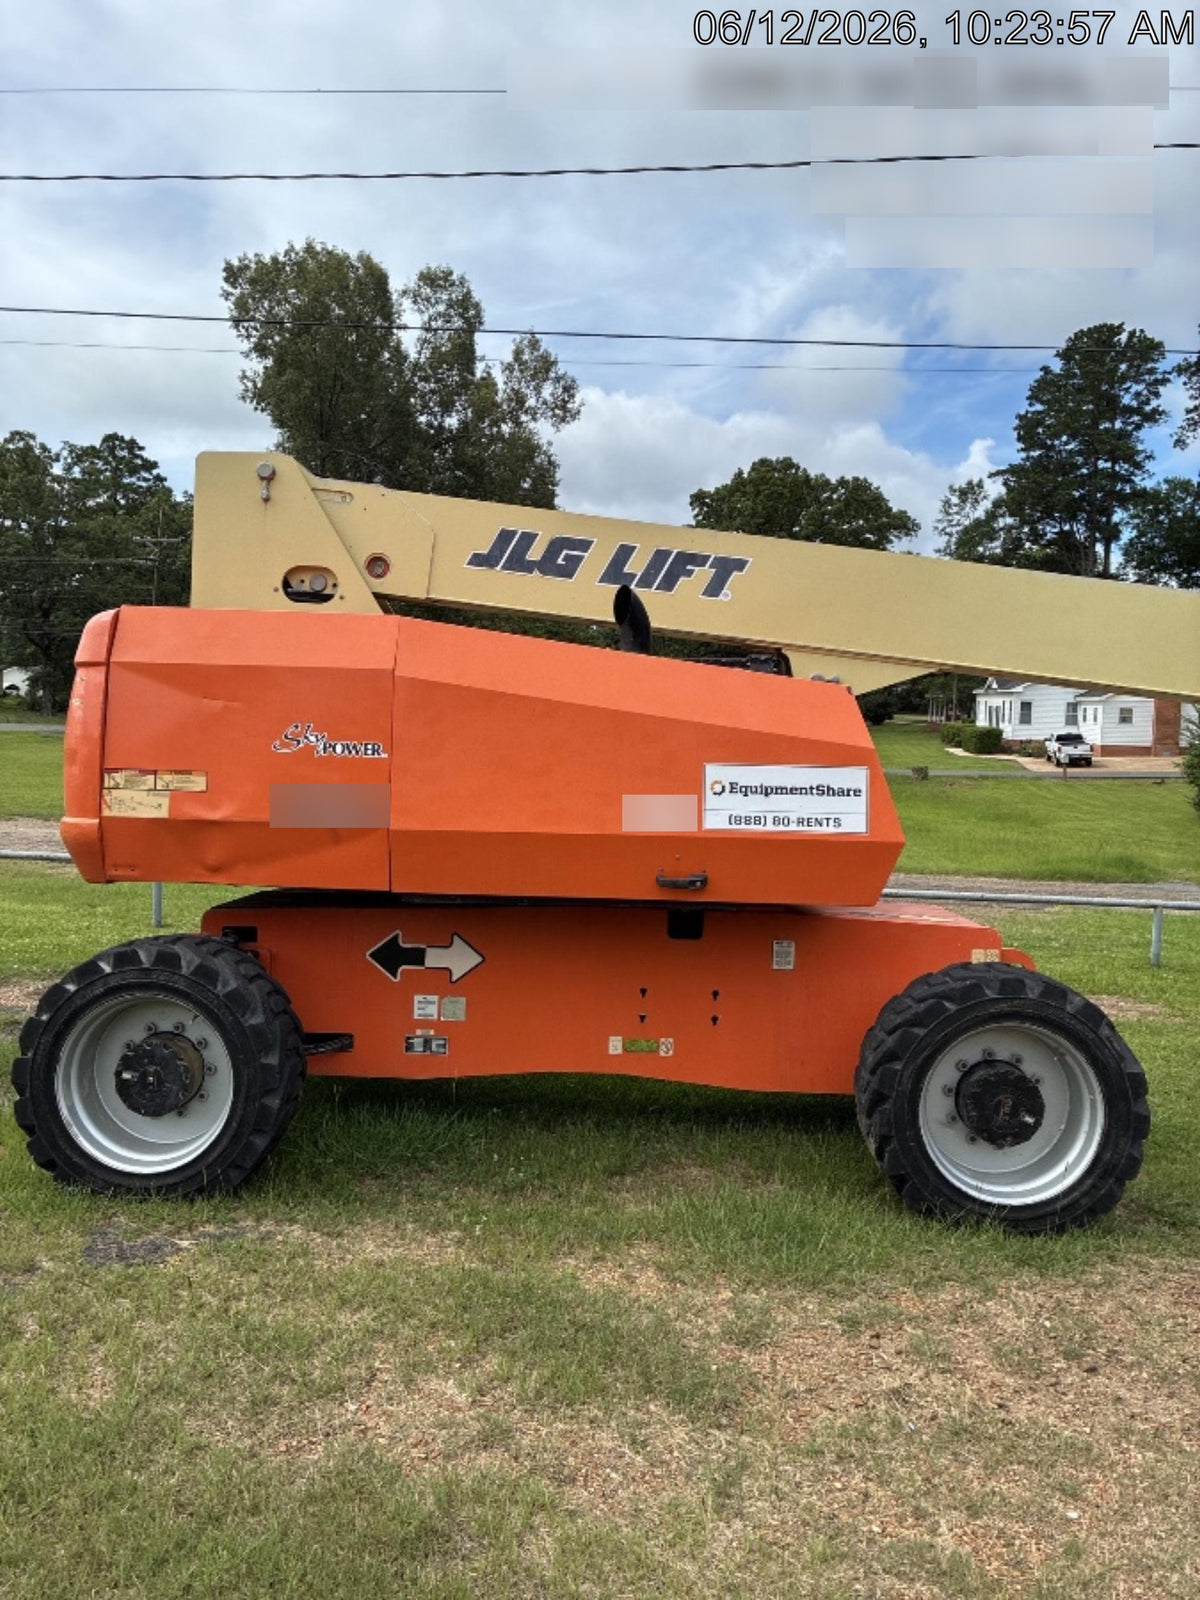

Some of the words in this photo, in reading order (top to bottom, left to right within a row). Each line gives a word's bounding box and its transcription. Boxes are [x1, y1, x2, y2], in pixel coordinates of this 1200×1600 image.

[464, 527, 597, 582] JLG
[596, 542, 753, 600] LIFT
[271, 723, 327, 758] Sky
[321, 741, 383, 758] POWER
[728, 781, 863, 798] EquipmentShare
[728, 813, 768, 827] (888)
[772, 815, 842, 829] 80-RENTS
